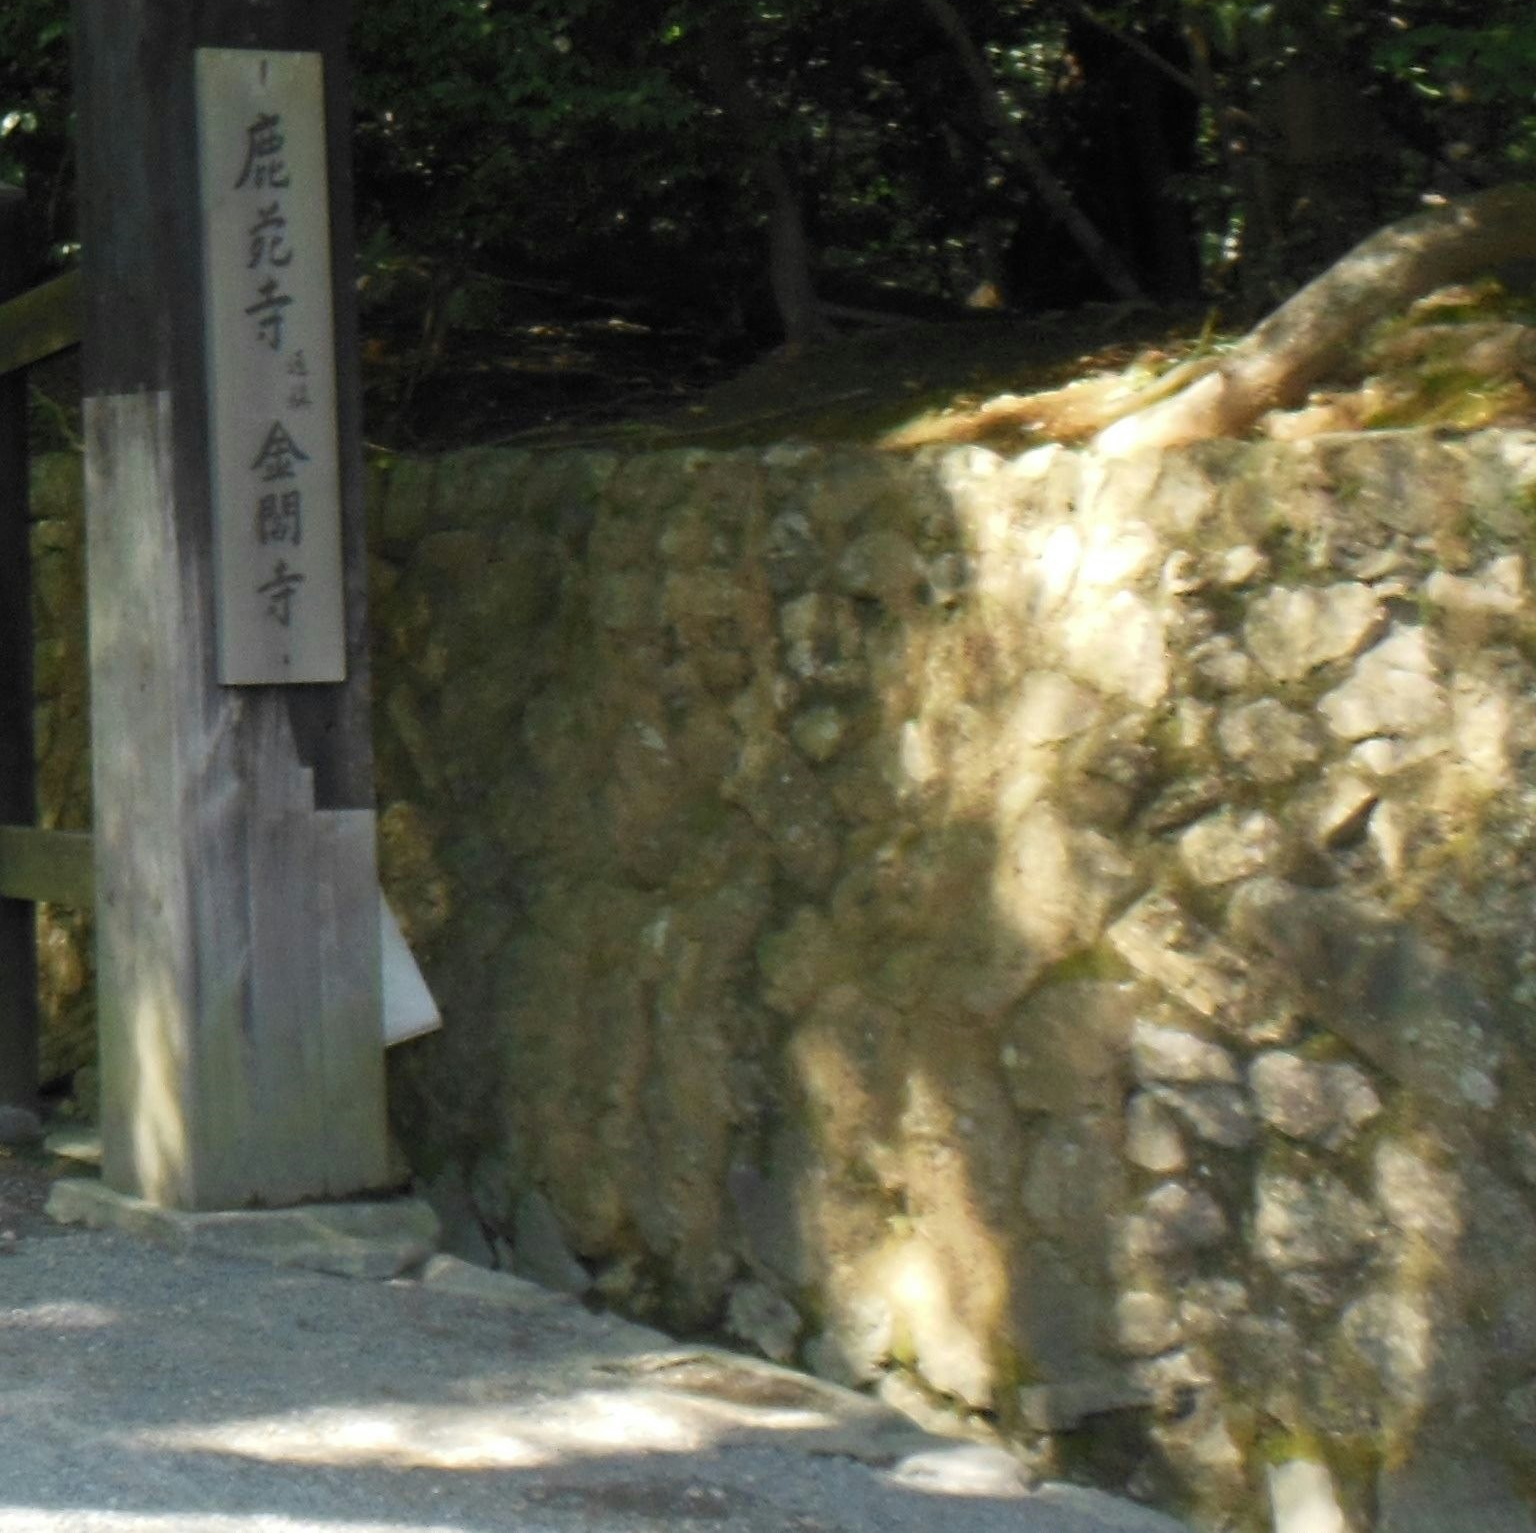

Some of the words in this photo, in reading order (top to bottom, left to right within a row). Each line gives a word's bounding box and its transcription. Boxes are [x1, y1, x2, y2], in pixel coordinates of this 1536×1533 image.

[234, 112, 293, 352] 鹿苑寺
[252, 420, 311, 627] 金閣寺
